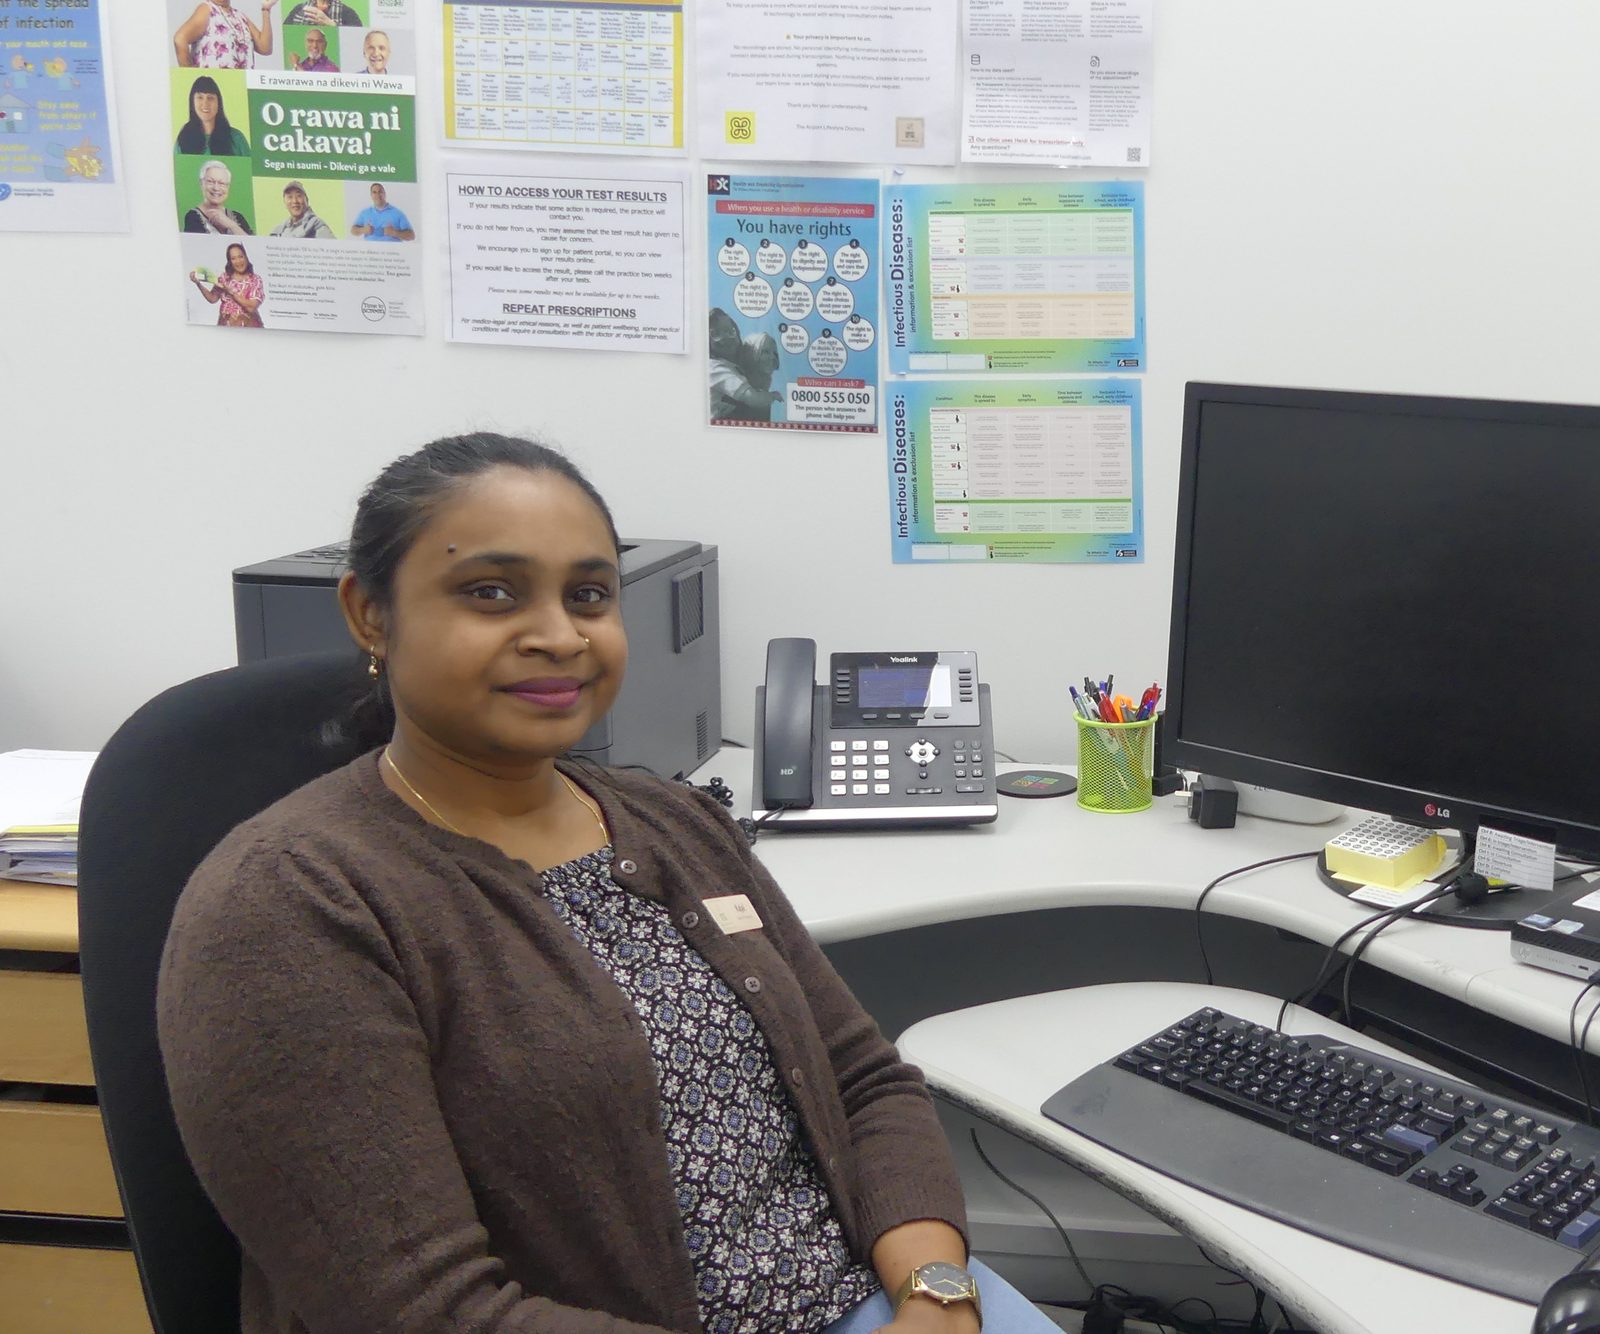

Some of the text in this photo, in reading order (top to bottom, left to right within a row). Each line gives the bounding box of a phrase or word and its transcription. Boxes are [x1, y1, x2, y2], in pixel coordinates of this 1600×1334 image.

[45, 0, 88, 10] spread
[16, 16, 74, 28] infection
[260, 75, 266, 84] E
[269, 78, 314, 86] rawarawa
[331, 78, 359, 88] dikevi
[373, 80, 402, 89] Wawa
[263, 102, 400, 130] O rawa ni
[264, 129, 371, 154] cakava!
[265, 159, 285, 171] Sega
[287, 160, 295, 169] ni
[297, 161, 321, 170] saumi
[330, 162, 357, 171] Dikevi
[359, 165, 369, 174] ga
[378, 164, 395, 173] vale
[459, 185, 667, 201] HOW TO ACCESS YOUR TEST RESULTS
[781, 205, 802, 213] health
[812, 206, 842, 215] disability
[737, 219, 851, 240] You have rights
[890, 199, 905, 347] Infectious Diseases:
[503, 304, 636, 316] REPEAT PRESCRIPTIONS
[908, 291, 916, 332] information
[792, 390, 870, 404] 0800 555 050
[893, 395, 908, 538] Infectious Diseases:
[910, 484, 918, 523] information
[1437, 808, 1450, 818] LG
